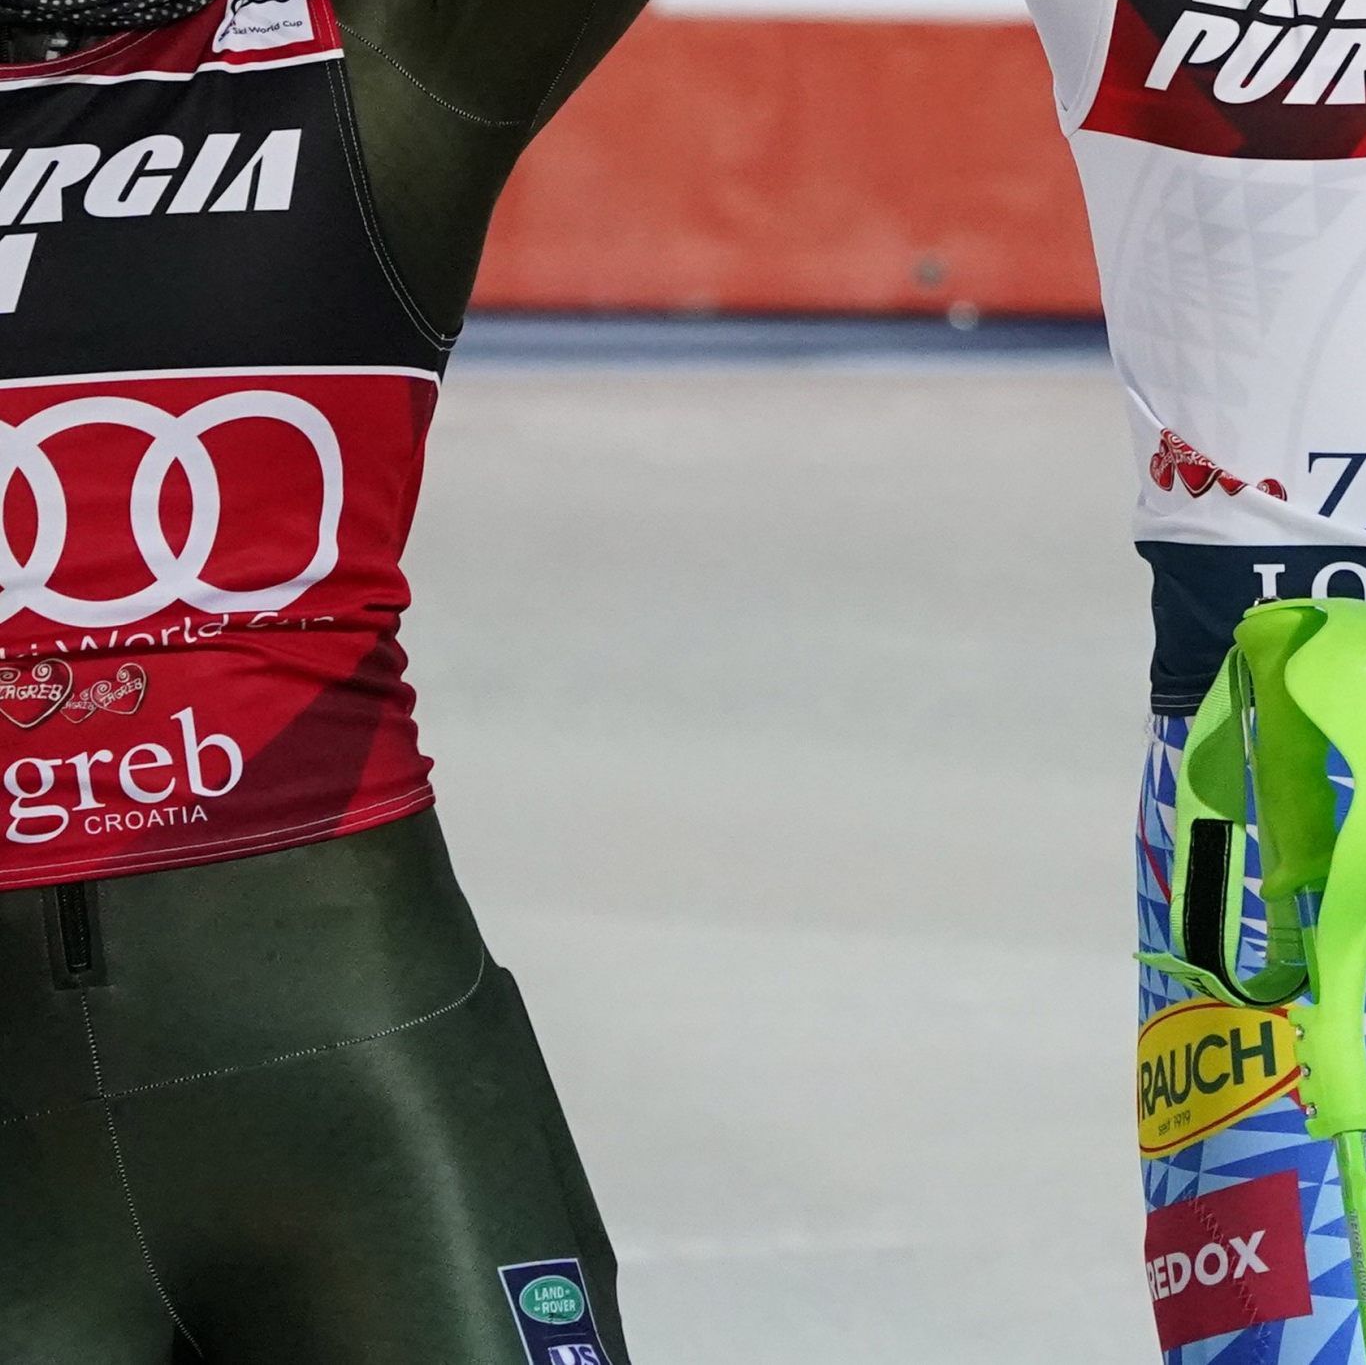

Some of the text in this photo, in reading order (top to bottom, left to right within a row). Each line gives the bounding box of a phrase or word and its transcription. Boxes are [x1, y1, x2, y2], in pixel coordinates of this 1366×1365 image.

[248, 23, 281, 35] World
[282, 20, 303, 28] Cup
[0, 128, 302, 226] RGIA
[84, 803, 209, 835] CROATIA
[1140, 1020, 1277, 1121] RAUCH
[534, 1286, 565, 1301] LAND
[541, 1299, 576, 1314] ROVER
